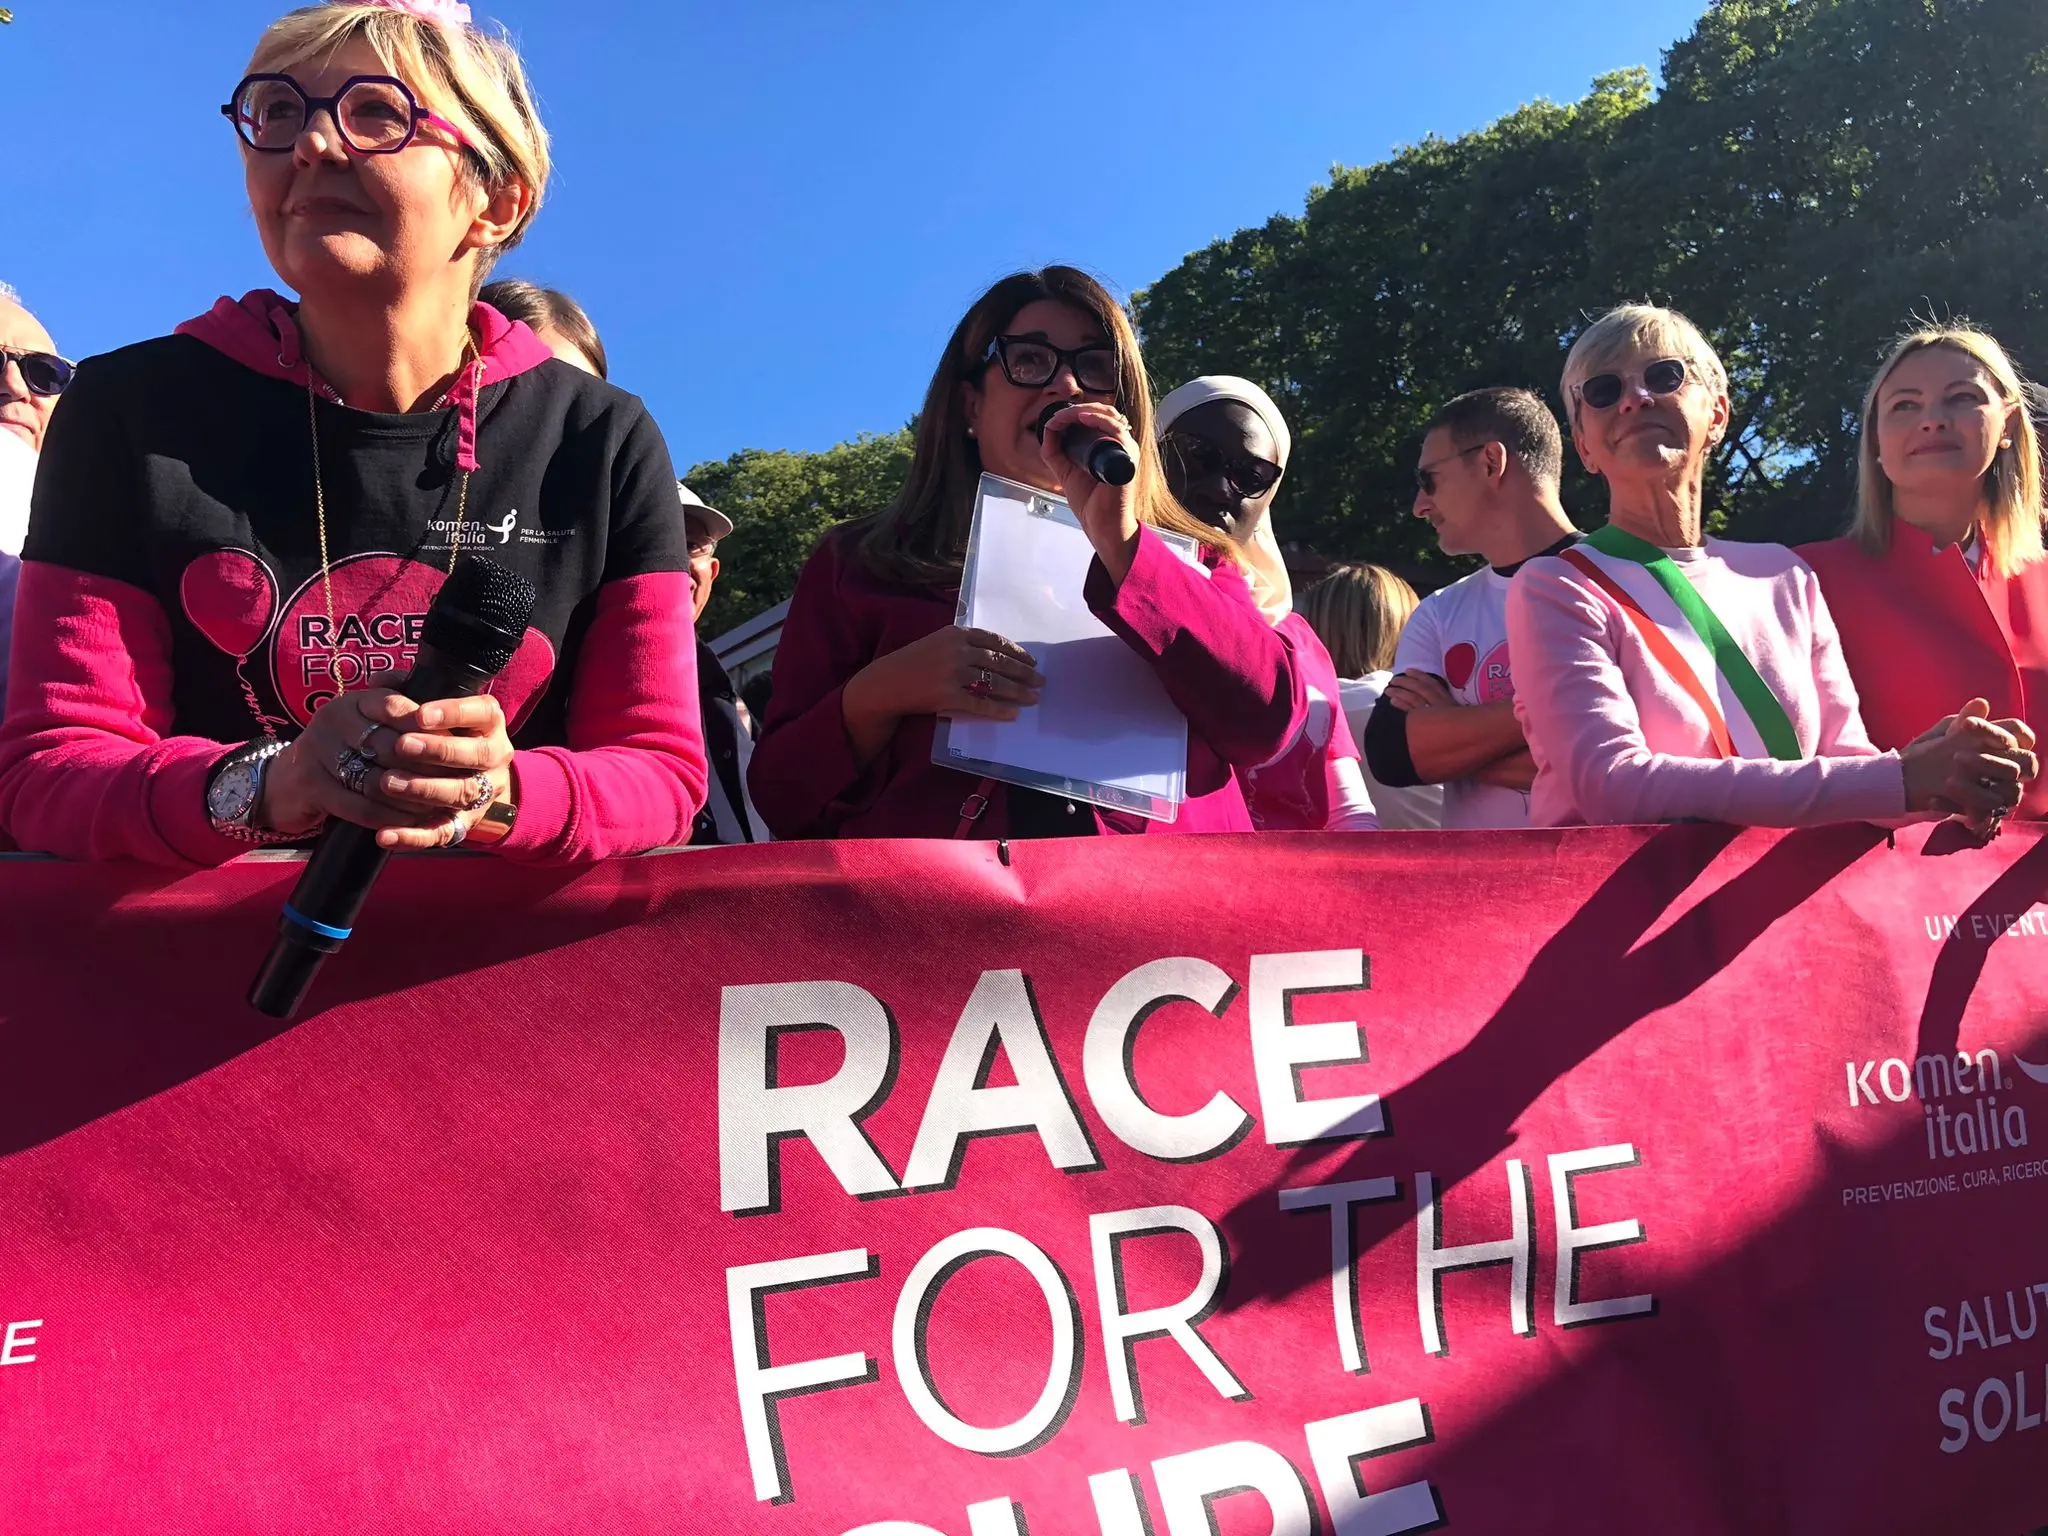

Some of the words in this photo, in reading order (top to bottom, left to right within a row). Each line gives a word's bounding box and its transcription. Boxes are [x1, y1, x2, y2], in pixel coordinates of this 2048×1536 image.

[520, 528, 535, 536] PER
[1924, 914, 1961, 941] UN
[1971, 911, 2048, 940] EVENT
[718, 948, 1388, 1217] RACE
[1923, 1096, 2029, 1160] italia
[1842, 1174, 1961, 1206] PREVENZIONE,
[1963, 1167, 2000, 1188] CURA,
[725, 1204, 1254, 1507] FOR
[1278, 1143, 1658, 1378] THE
